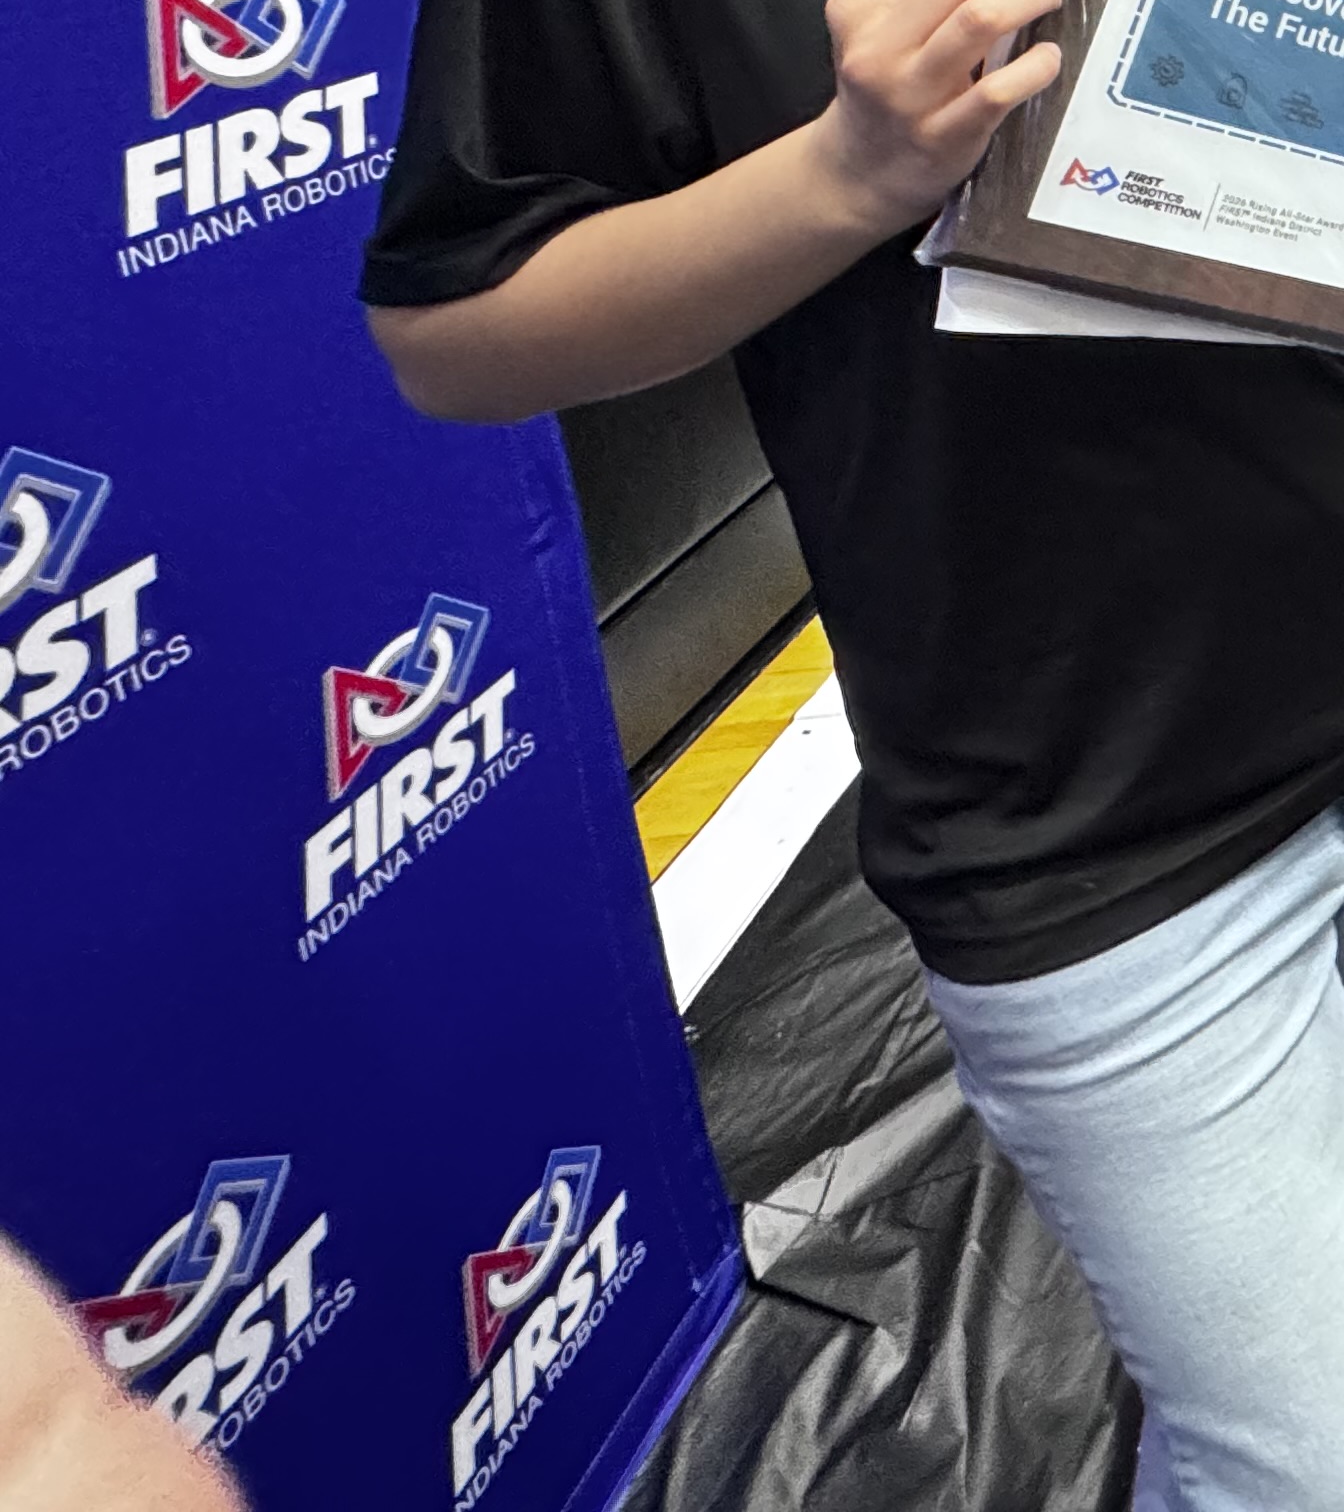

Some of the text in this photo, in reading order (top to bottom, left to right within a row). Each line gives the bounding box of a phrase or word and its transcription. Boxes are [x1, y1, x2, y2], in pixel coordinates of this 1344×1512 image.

[125, 71, 379, 238] FIRST
[1117, 192, 1202, 221] COMPETITION
[1121, 181, 1185, 205] ROBOTICS
[1125, 170, 1165, 188] FIRST
[116, 205, 258, 278] INDIANA
[298, 733, 536, 962] INDIANA ROBOTICS
[304, 668, 515, 923] FIRST
[217, 1278, 357, 1449] OBOTICS
[452, 1189, 628, 1498] FIRST
[455, 1240, 648, 1512] NDIANA ROBOTICS
